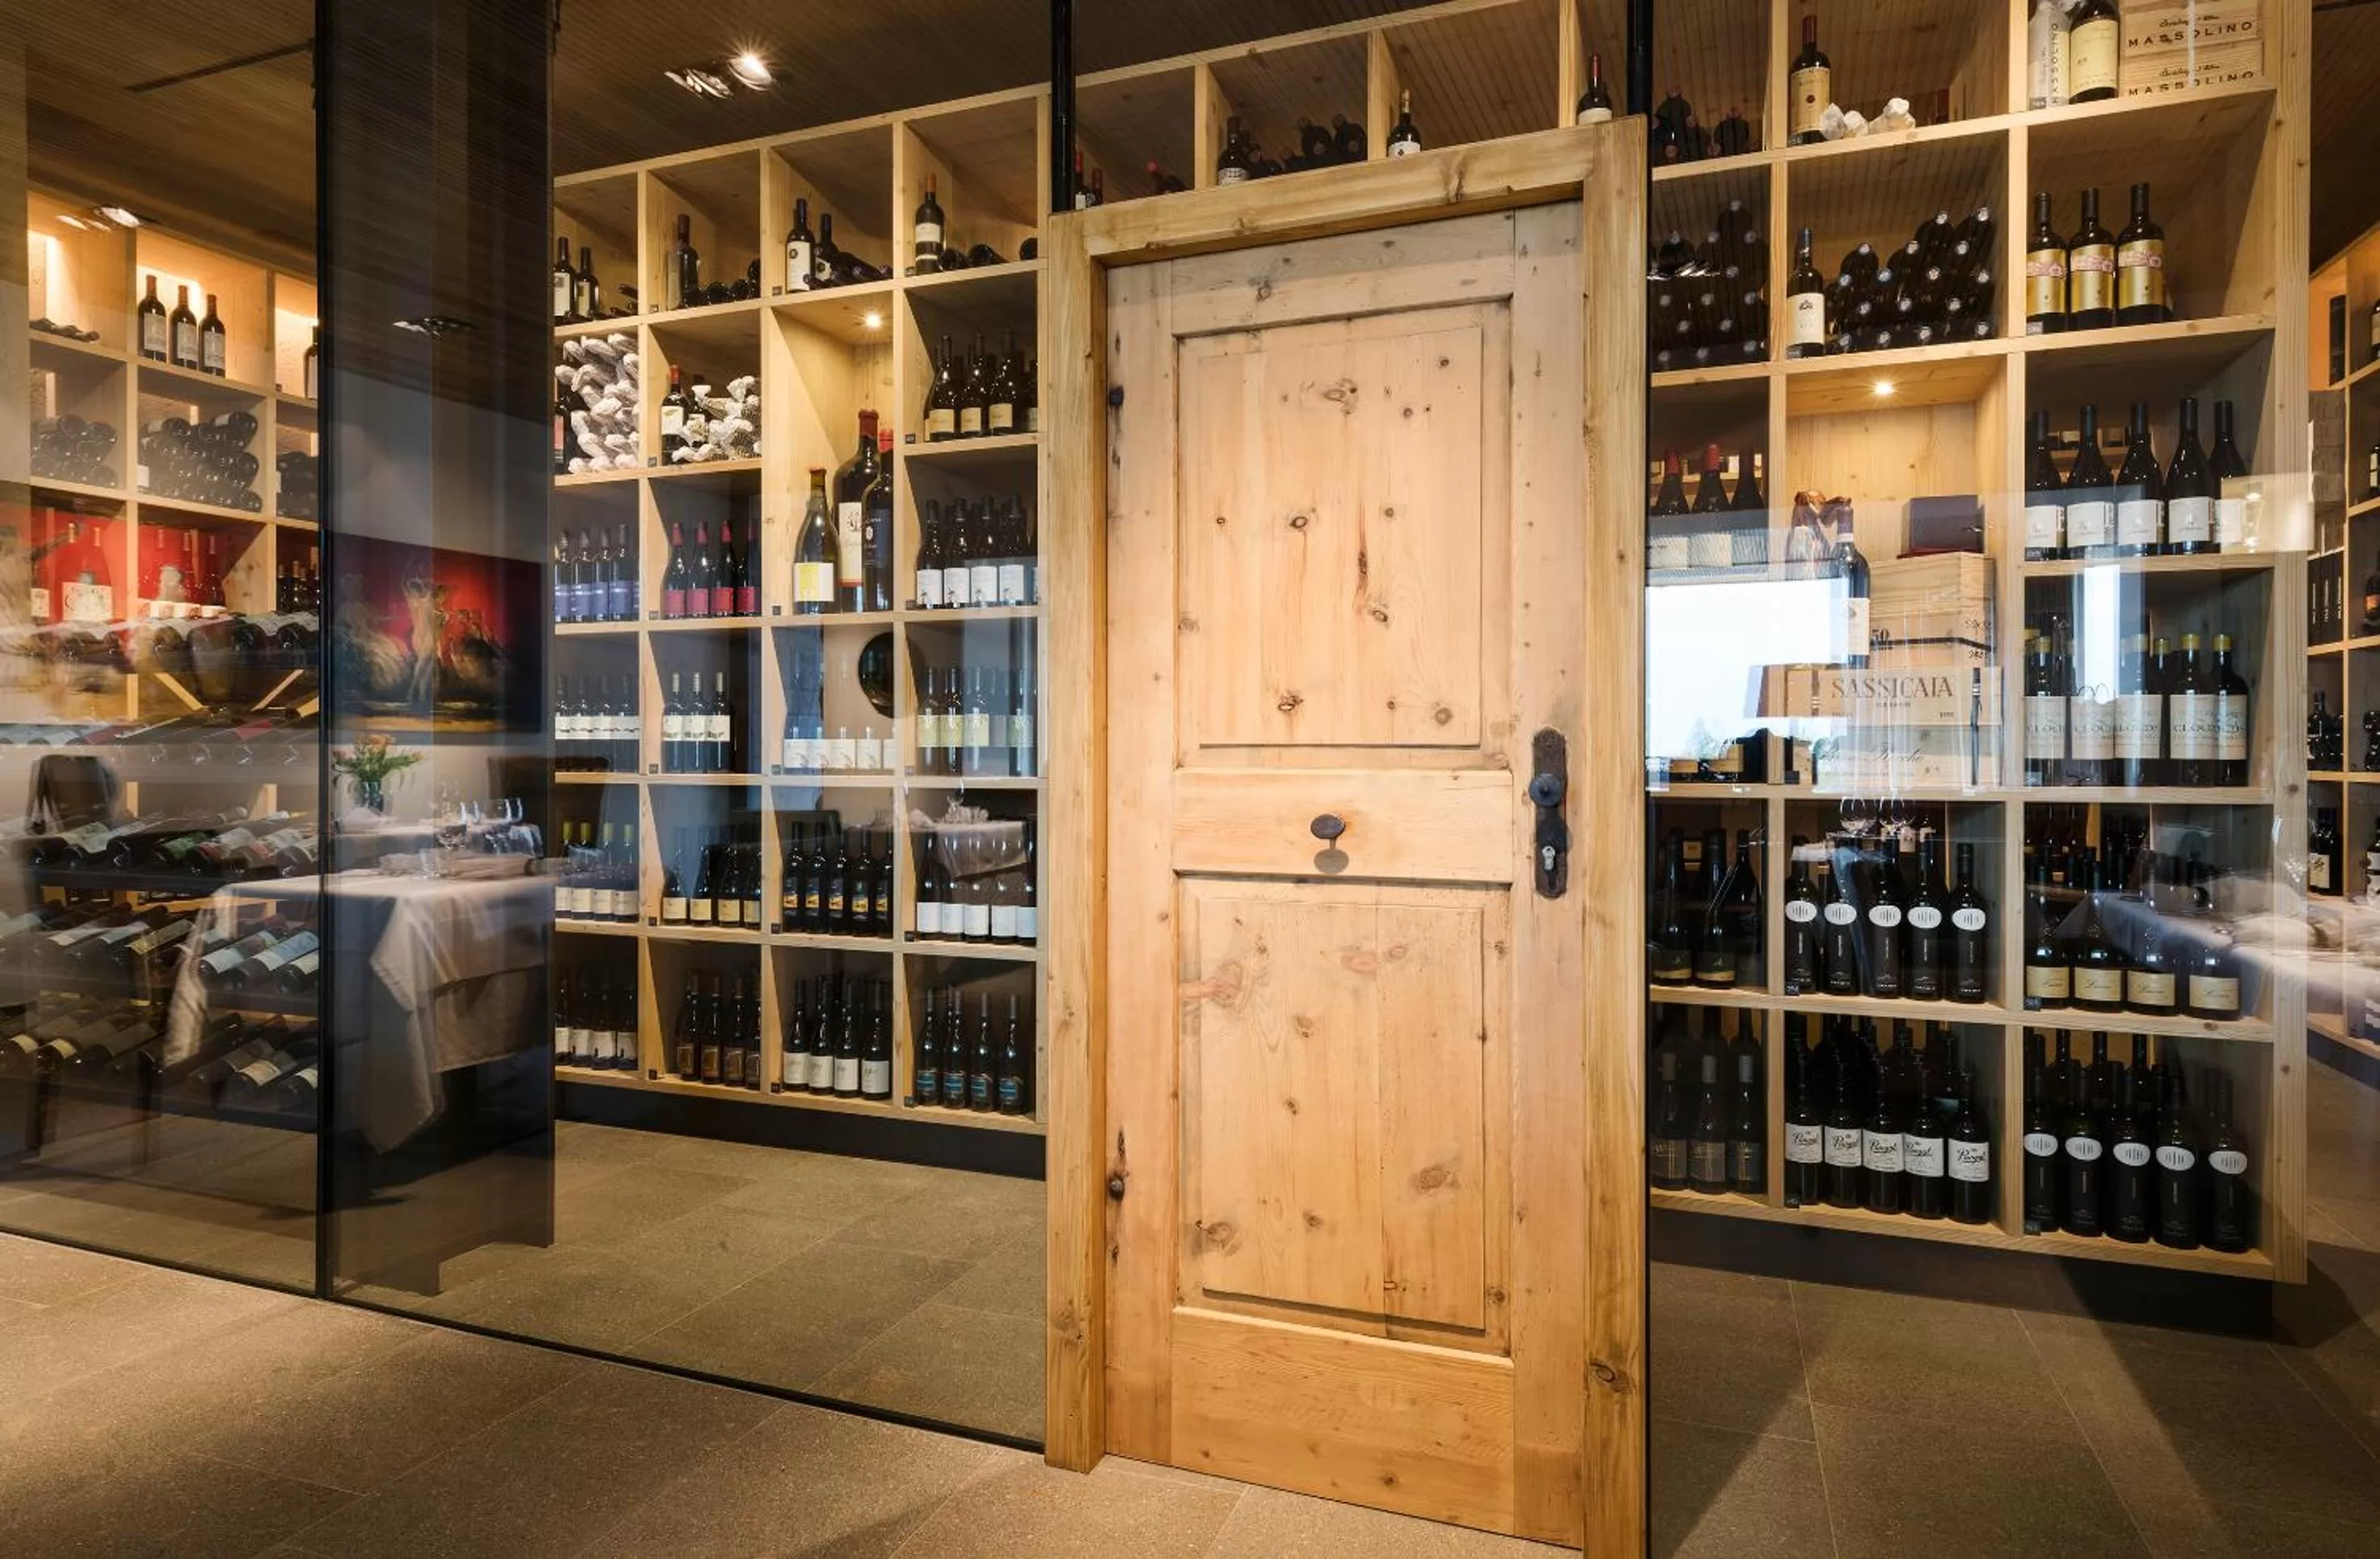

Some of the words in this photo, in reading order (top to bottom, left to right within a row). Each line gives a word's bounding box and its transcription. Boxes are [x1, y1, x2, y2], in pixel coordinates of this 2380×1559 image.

[2128, 21, 2253, 48] MASSOLINO
[2128, 70, 2255, 97] MASSOLINO
[1831, 676, 1954, 698] SASSICAIA
